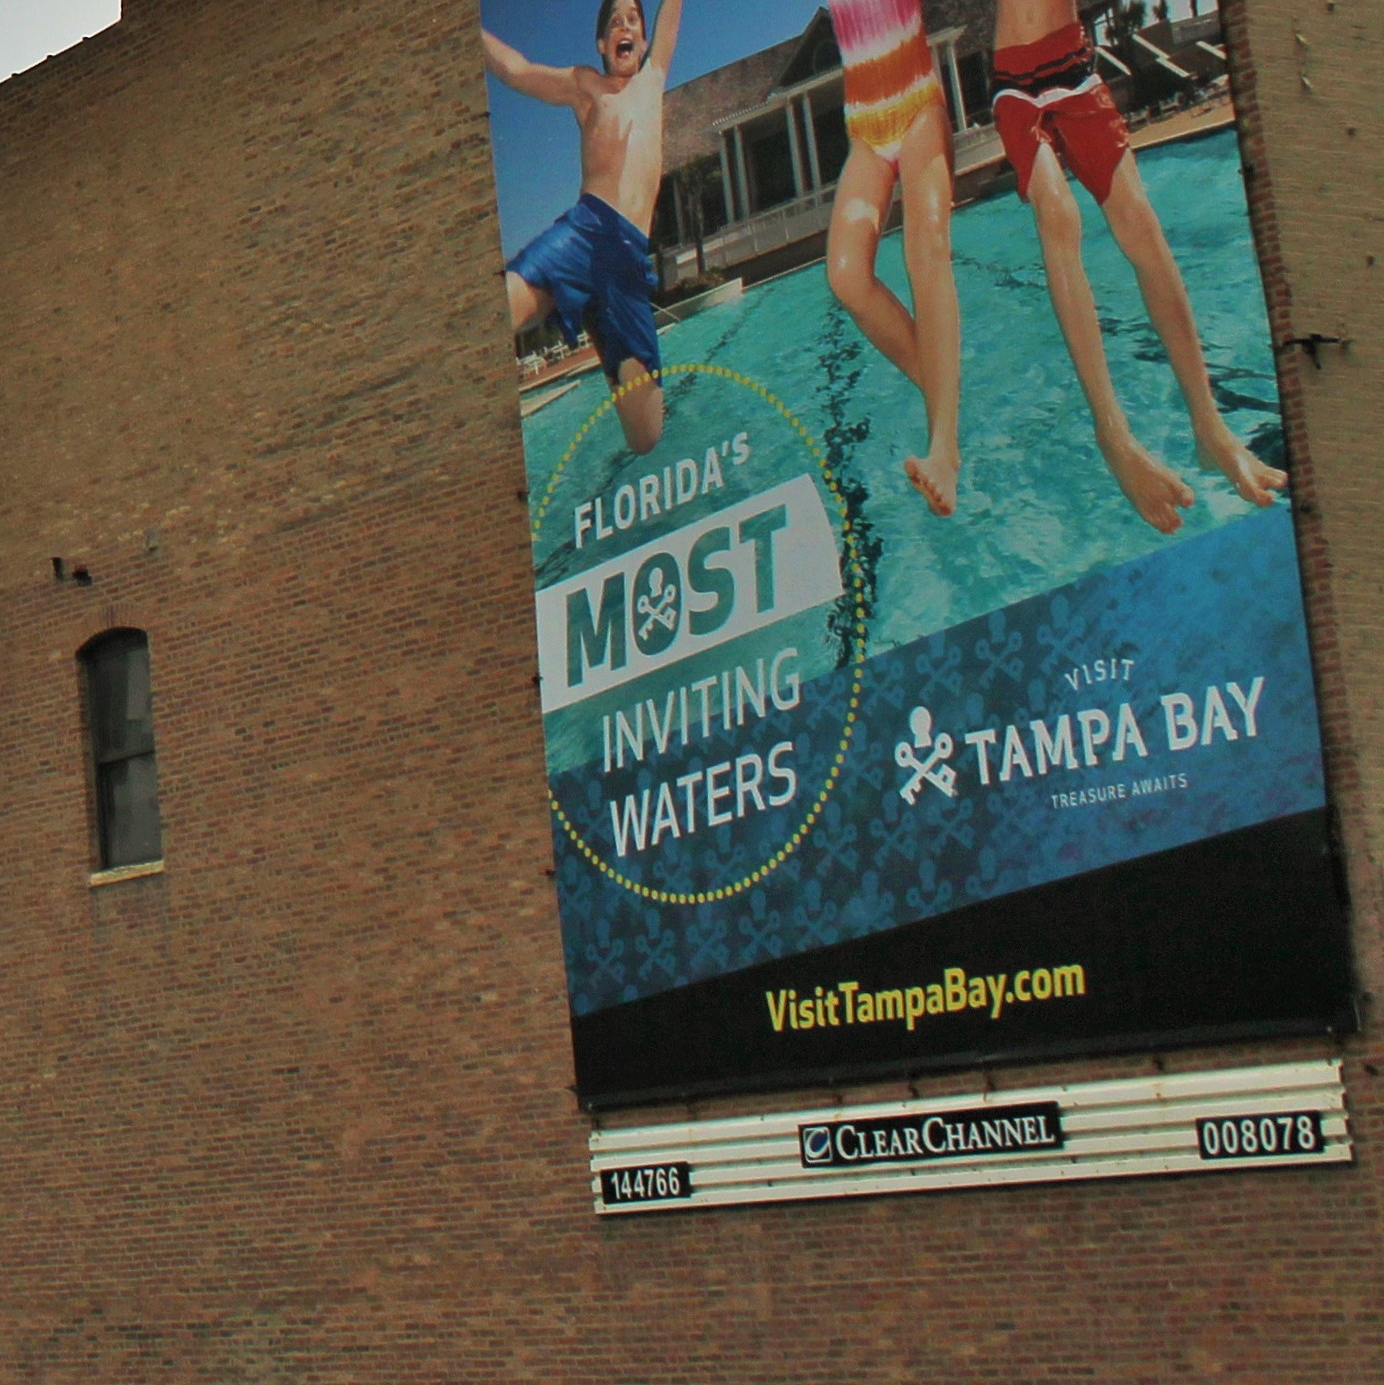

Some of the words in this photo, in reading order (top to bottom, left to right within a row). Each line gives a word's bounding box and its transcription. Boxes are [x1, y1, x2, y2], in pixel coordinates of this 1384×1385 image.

[566, 503, 789, 688] MOST
[1064, 658, 1135, 691] VISIT
[602, 647, 800, 773] INVITING
[964, 702, 1148, 785] TAMPA
[1160, 676, 1265, 751] BAY
[609, 741, 797, 858] WATERS
[1051, 783, 1126, 809] TREASURE
[1131, 773, 1188, 797] AWAITS
[766, 964, 1086, 1031] VisitTampaBay.com
[1203, 1115, 1315, 1155] 008078
[611, 1167, 680, 1200] 144766
